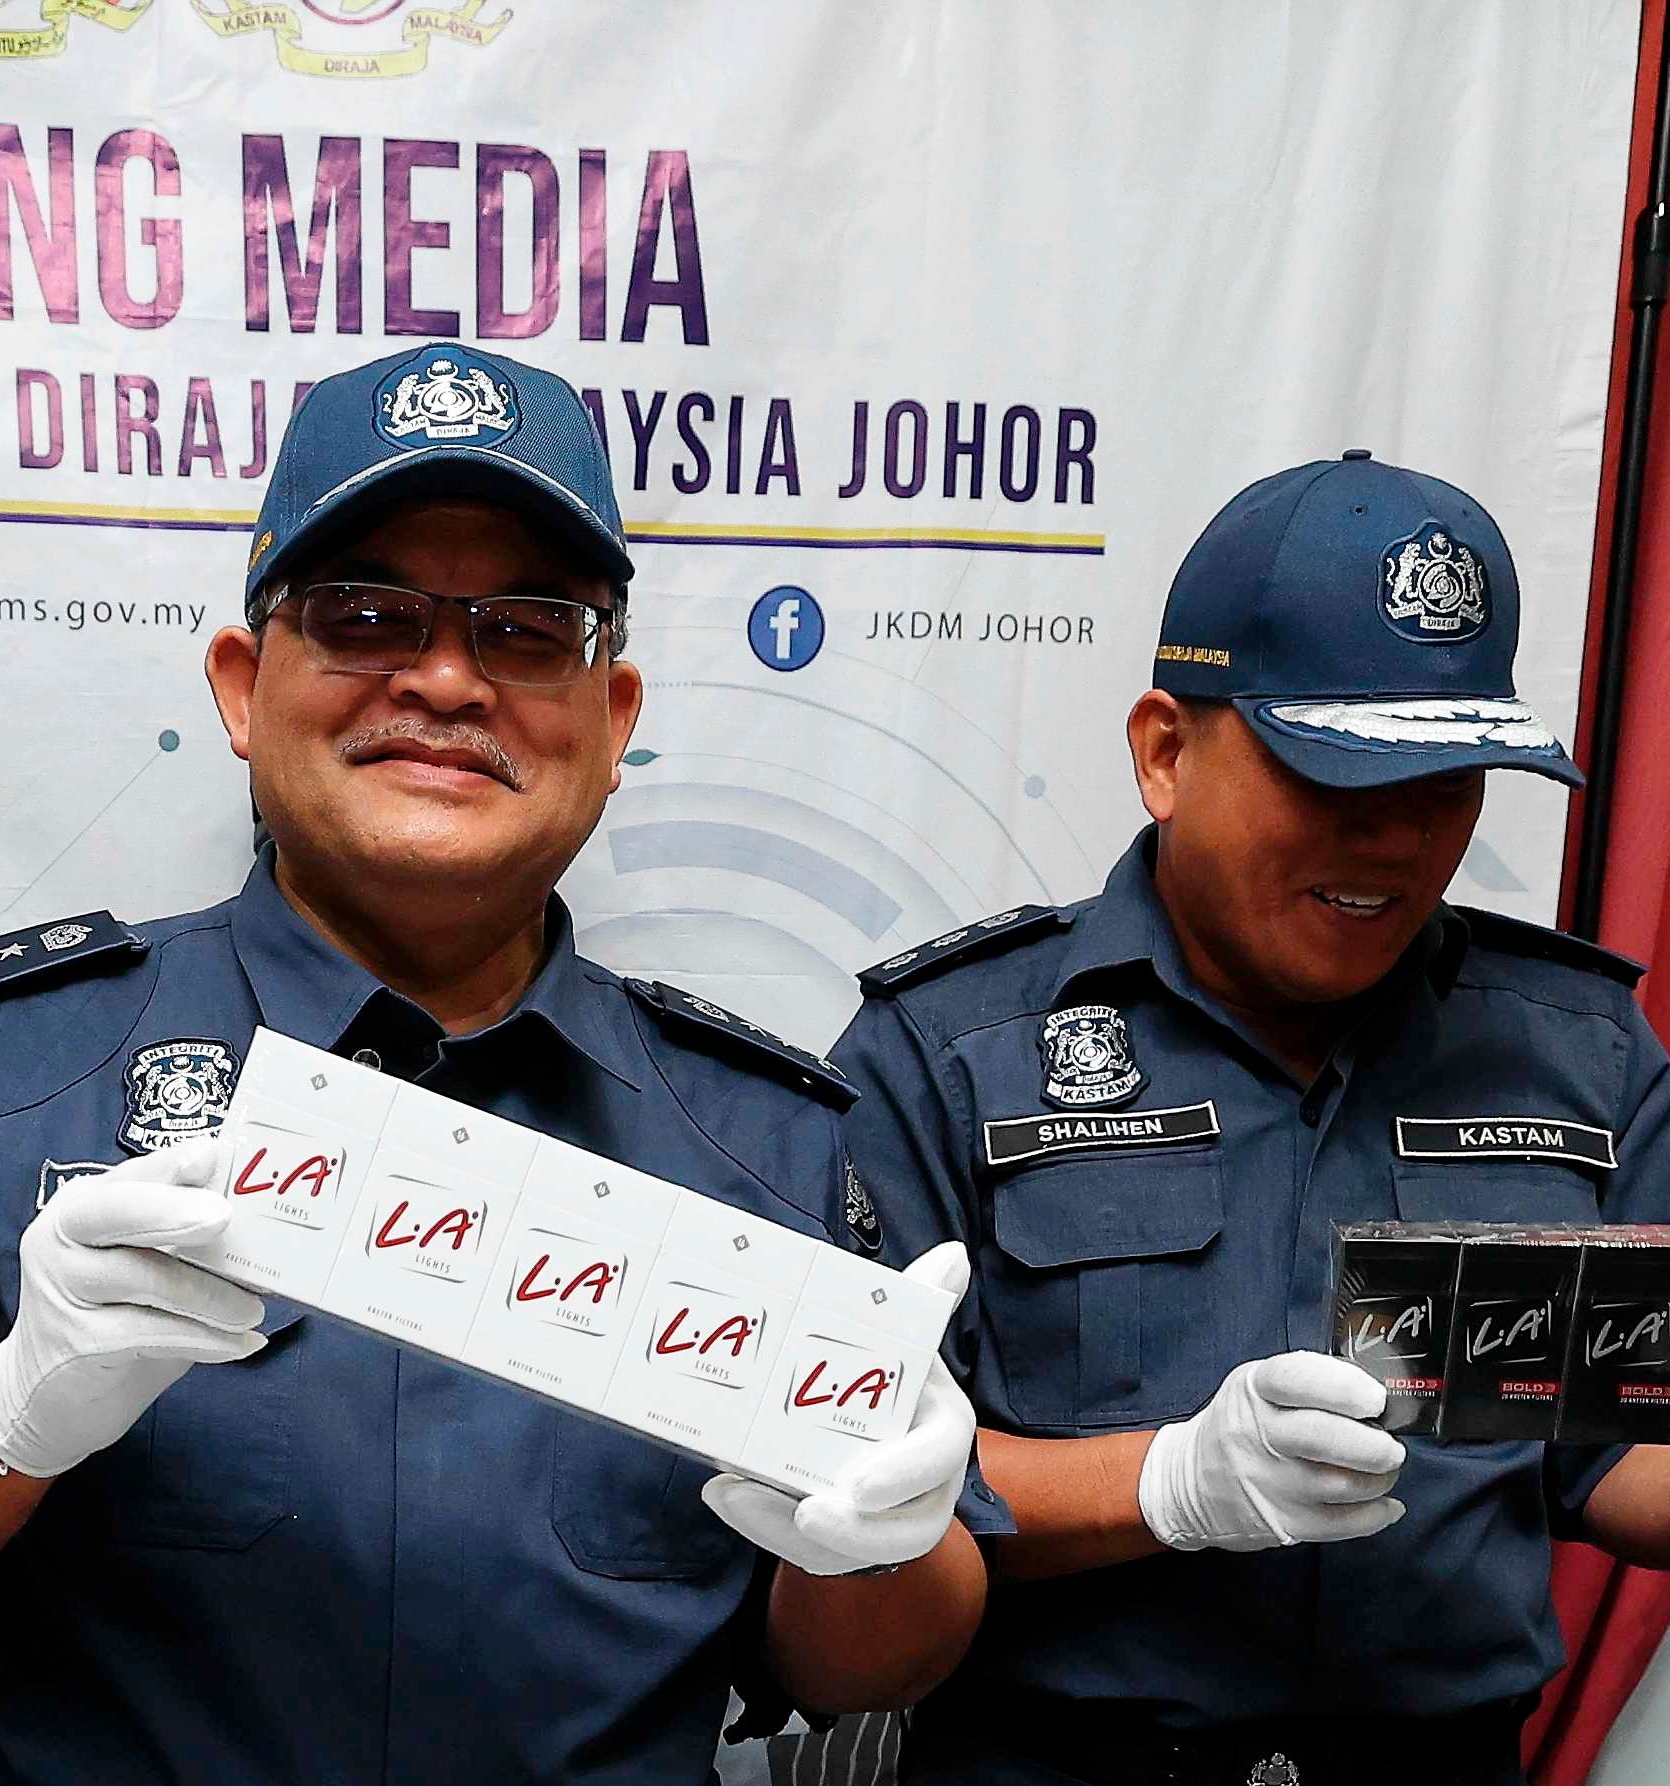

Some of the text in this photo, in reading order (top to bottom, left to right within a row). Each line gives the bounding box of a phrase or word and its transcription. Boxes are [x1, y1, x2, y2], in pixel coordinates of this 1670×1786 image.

[222, 11, 288, 31] KASTAM
[324, 59, 380, 74] DIRAJA
[241, 133, 710, 347] MEDIA
[16, 367, 316, 479] DIRAJ
[839, 399, 1096, 505] JOHOR
[865, 608, 1095, 646] JKDM JOHOR
[1063, 1079, 1130, 1100] KASTAM
[1037, 1116, 1164, 1143] SHALIHEN
[1458, 1126, 1566, 1150] KASTAM
[273, 1202, 309, 1220] LIGHTS
[415, 1254, 451, 1273] LIGHTS
[555, 1307, 591, 1326] LIGHTS
[695, 1360, 730, 1380] LIGHTS
[1386, 1377, 1429, 1391] BOLD
[1502, 1381, 1543, 1393] BOLD
[1622, 1386, 1662, 1397] BOLD
[832, 1413, 867, 1432] LIGHTS
